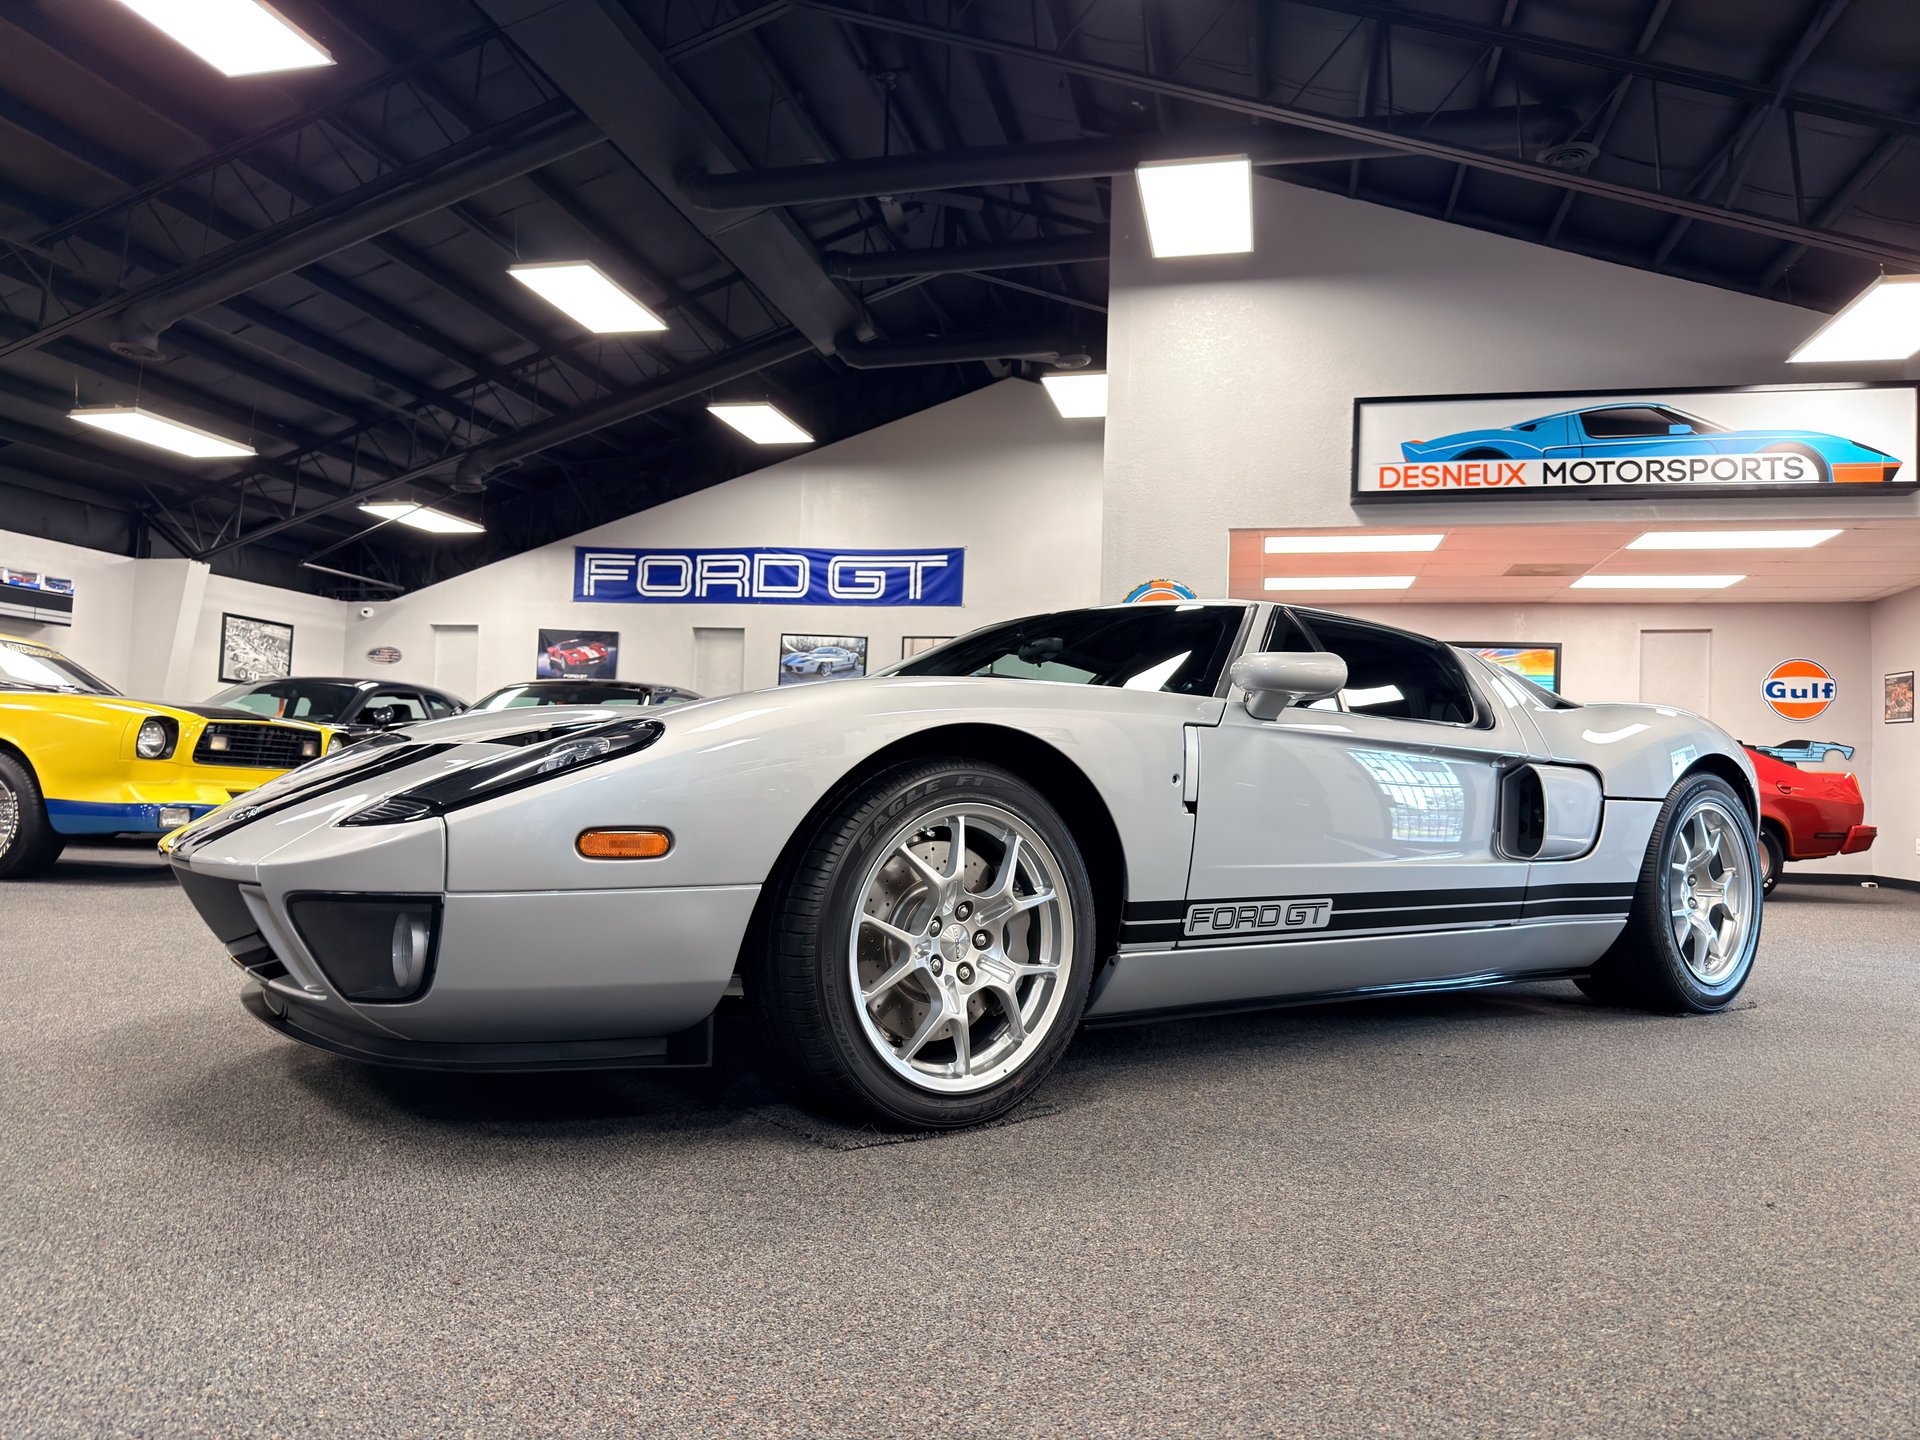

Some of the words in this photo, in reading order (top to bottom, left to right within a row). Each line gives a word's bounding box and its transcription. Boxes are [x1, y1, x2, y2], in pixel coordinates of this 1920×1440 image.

[1378, 462, 1528, 490] DESNEUX
[1542, 457, 1805, 486] MOTORSPORTS
[583, 552, 811, 599] FORD
[828, 554, 949, 601] GT
[1765, 681, 1834, 699] Gulf
[858, 779, 943, 852] EAGLE
[955, 775, 986, 787] F1
[1189, 904, 1282, 932] FORD
[1285, 901, 1329, 926] GT
